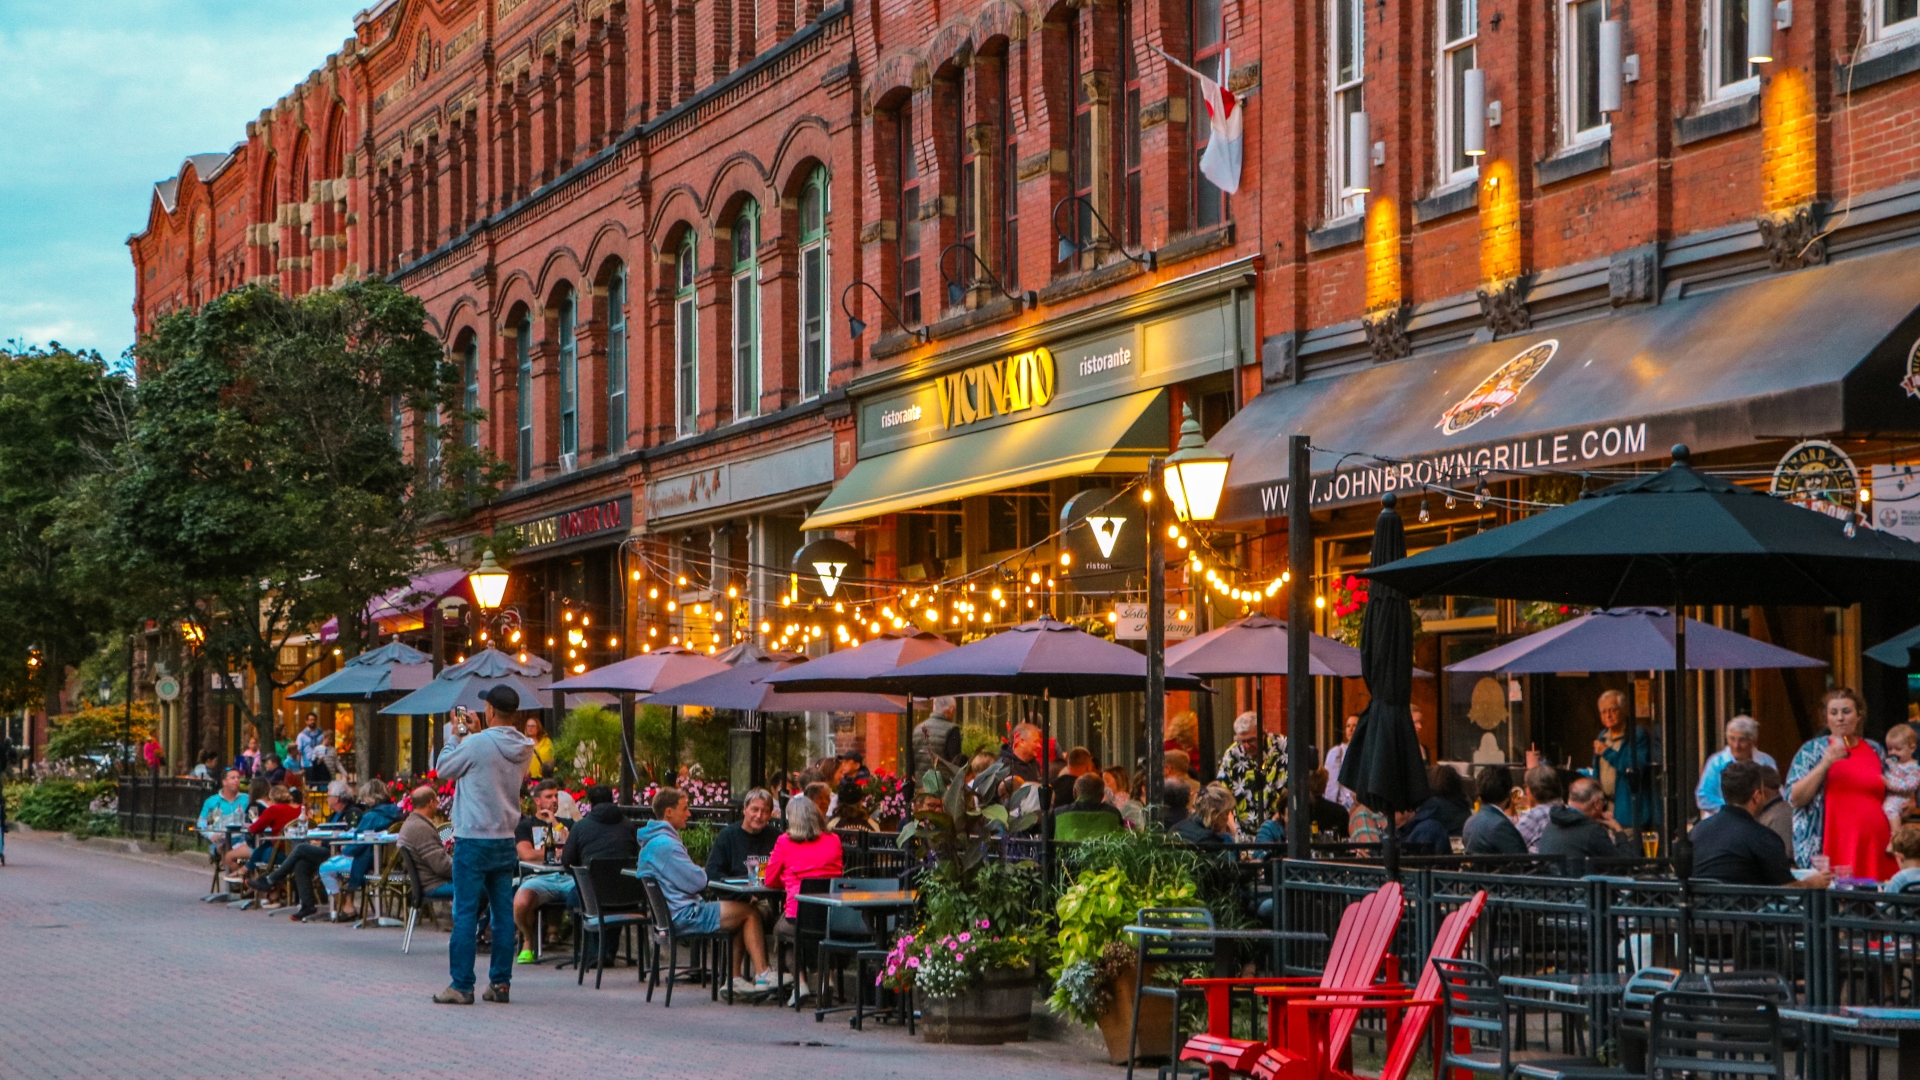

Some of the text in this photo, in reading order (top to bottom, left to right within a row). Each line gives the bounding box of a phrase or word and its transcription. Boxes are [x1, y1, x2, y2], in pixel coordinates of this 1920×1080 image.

[881, 347, 1131, 430] ristorante VICINATO ristorante
[528, 516, 557, 547] HOUSE
[560, 506, 600, 539] LOBSTER
